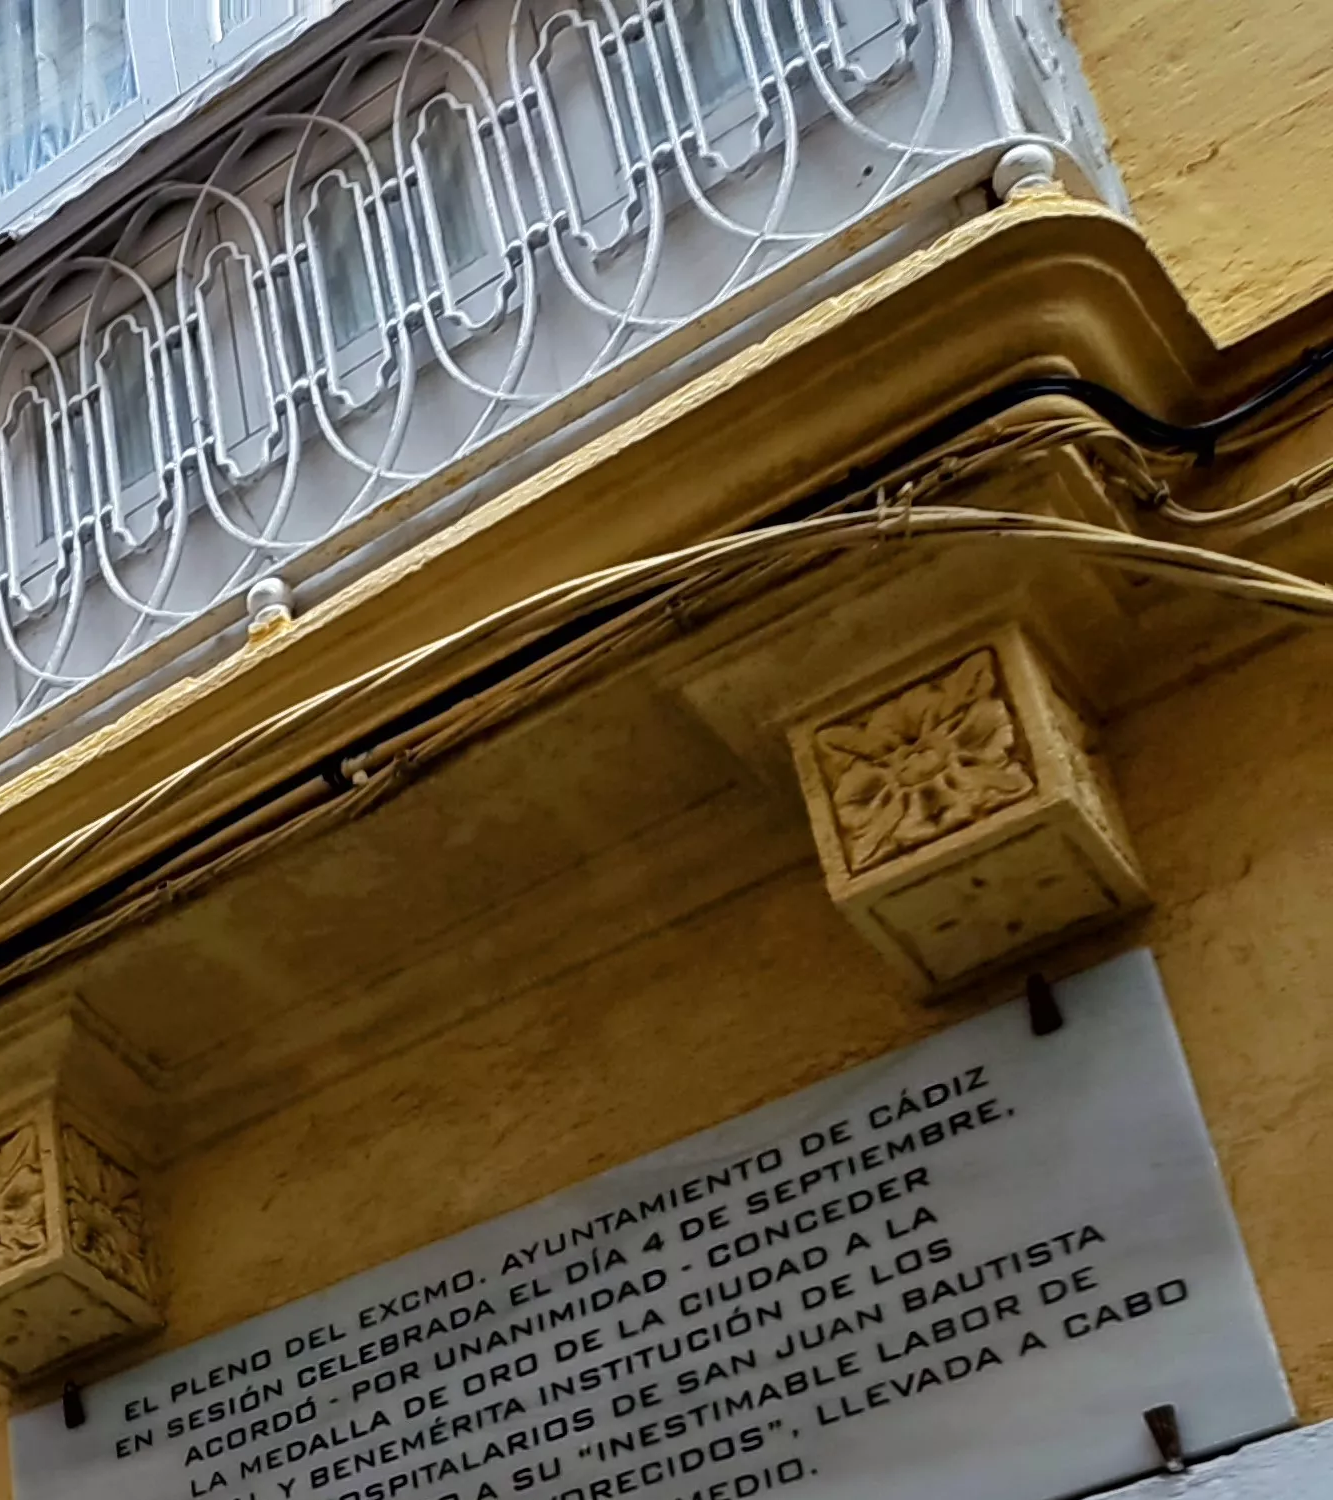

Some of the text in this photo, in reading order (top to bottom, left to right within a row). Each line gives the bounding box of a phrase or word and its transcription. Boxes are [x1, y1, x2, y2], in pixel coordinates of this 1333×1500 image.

[114, 1428, 153, 1460] EN
[166, 1377, 283, 1439] SESIÓN
[295, 1298, 496, 1389] CELEBRADA
[508, 1277, 552, 1307] EL
[564, 1246, 627, 1285] DÍA
[641, 1230, 665, 1253] 4
[678, 1204, 730, 1242] DE
[123, 1064, 989, 1422] EL PLENO DEL EXCMO. AYUNTAMIENTO DE CÁDIZ
[183, 1394, 317, 1467] ACORDÓ
[350, 1360, 421, 1403] POR
[432, 1268, 668, 1371] UNANIMIDAD
[705, 1165, 931, 1269] CONCEDER
[189, 1205, 938, 1498] LA MEDALLA DE ORO DE LA CIUDAD A LA
[275, 1476, 296, 1499] Y
[308, 1396, 526, 1490] BENEMÉRITA
[537, 1299, 783, 1407] INSTITUCIÓN
[799, 1272, 856, 1311] DE
[868, 1236, 953, 1286] LOS
[610, 1382, 663, 1419] DE
[675, 1348, 757, 1395] SAN
[774, 1302, 884, 1360] JUAN
[900, 1224, 1106, 1314] BAUTISTA
[815, 1345, 1003, 1427] LLEVADA
[1018, 1330, 1048, 1357] A
[1061, 1277, 1189, 1339] CABO
[511, 1456, 561, 1492] SU
[875, 1293, 1021, 1363] LABOR
[1037, 1265, 1098, 1306] DE
